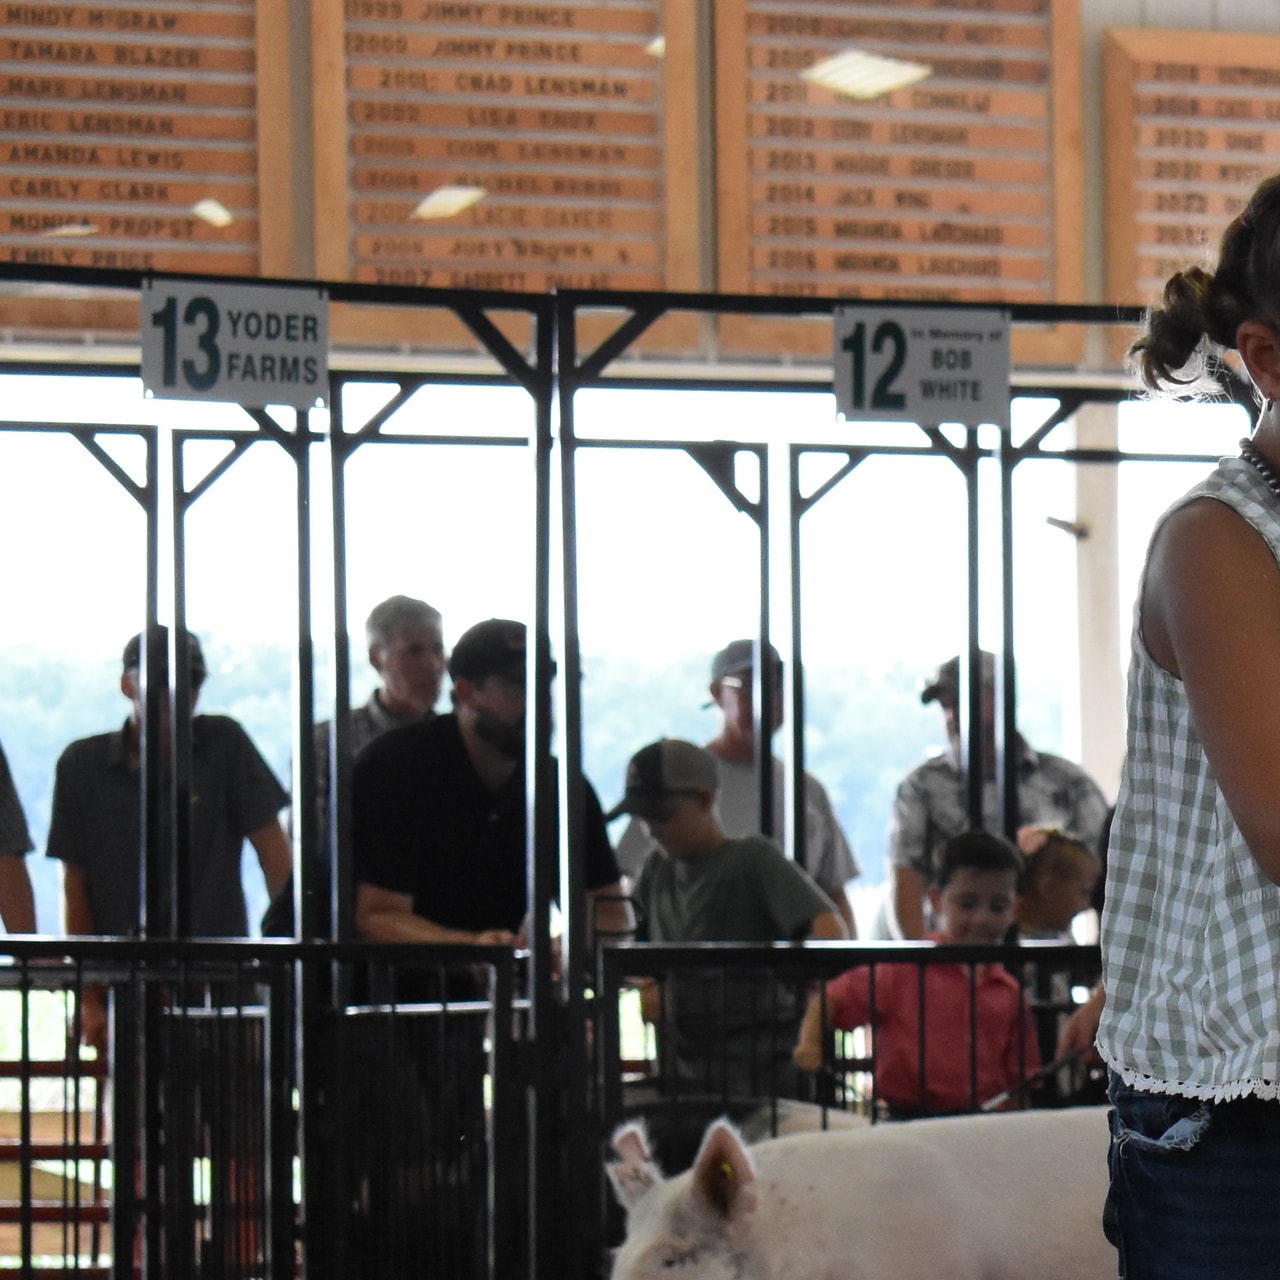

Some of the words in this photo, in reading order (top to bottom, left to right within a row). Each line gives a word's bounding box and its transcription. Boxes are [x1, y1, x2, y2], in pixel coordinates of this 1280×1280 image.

[7, 8, 73, 25] MINDY
[421, 3, 485, 21] JIMMY
[499, 6, 575, 27] PRINCE
[10, 40, 96, 62] TAMARA
[115, 46, 199, 66] BLAZER
[431, 39, 496, 57] JIMMY
[505, 42, 580, 62] PRINCE
[81, 82, 187, 101] LENSMAN
[525, 76, 628, 97] LENSMAN
[4, 112, 51, 130] ERIC
[69, 115, 174, 134] LENSMAN
[9, 145, 99, 163] AMANDA
[117, 150, 183, 169] LEWIS
[10, 179, 80, 197] CARLY
[100, 184, 169, 200] CLARK
[152, 296, 221, 392] 13
[227, 311, 319, 342] YODER
[227, 352, 318, 384] FARMS
[841, 320, 909, 410] 12
[931, 348, 973, 370] BOB
[920, 380, 983, 402] WHITE
